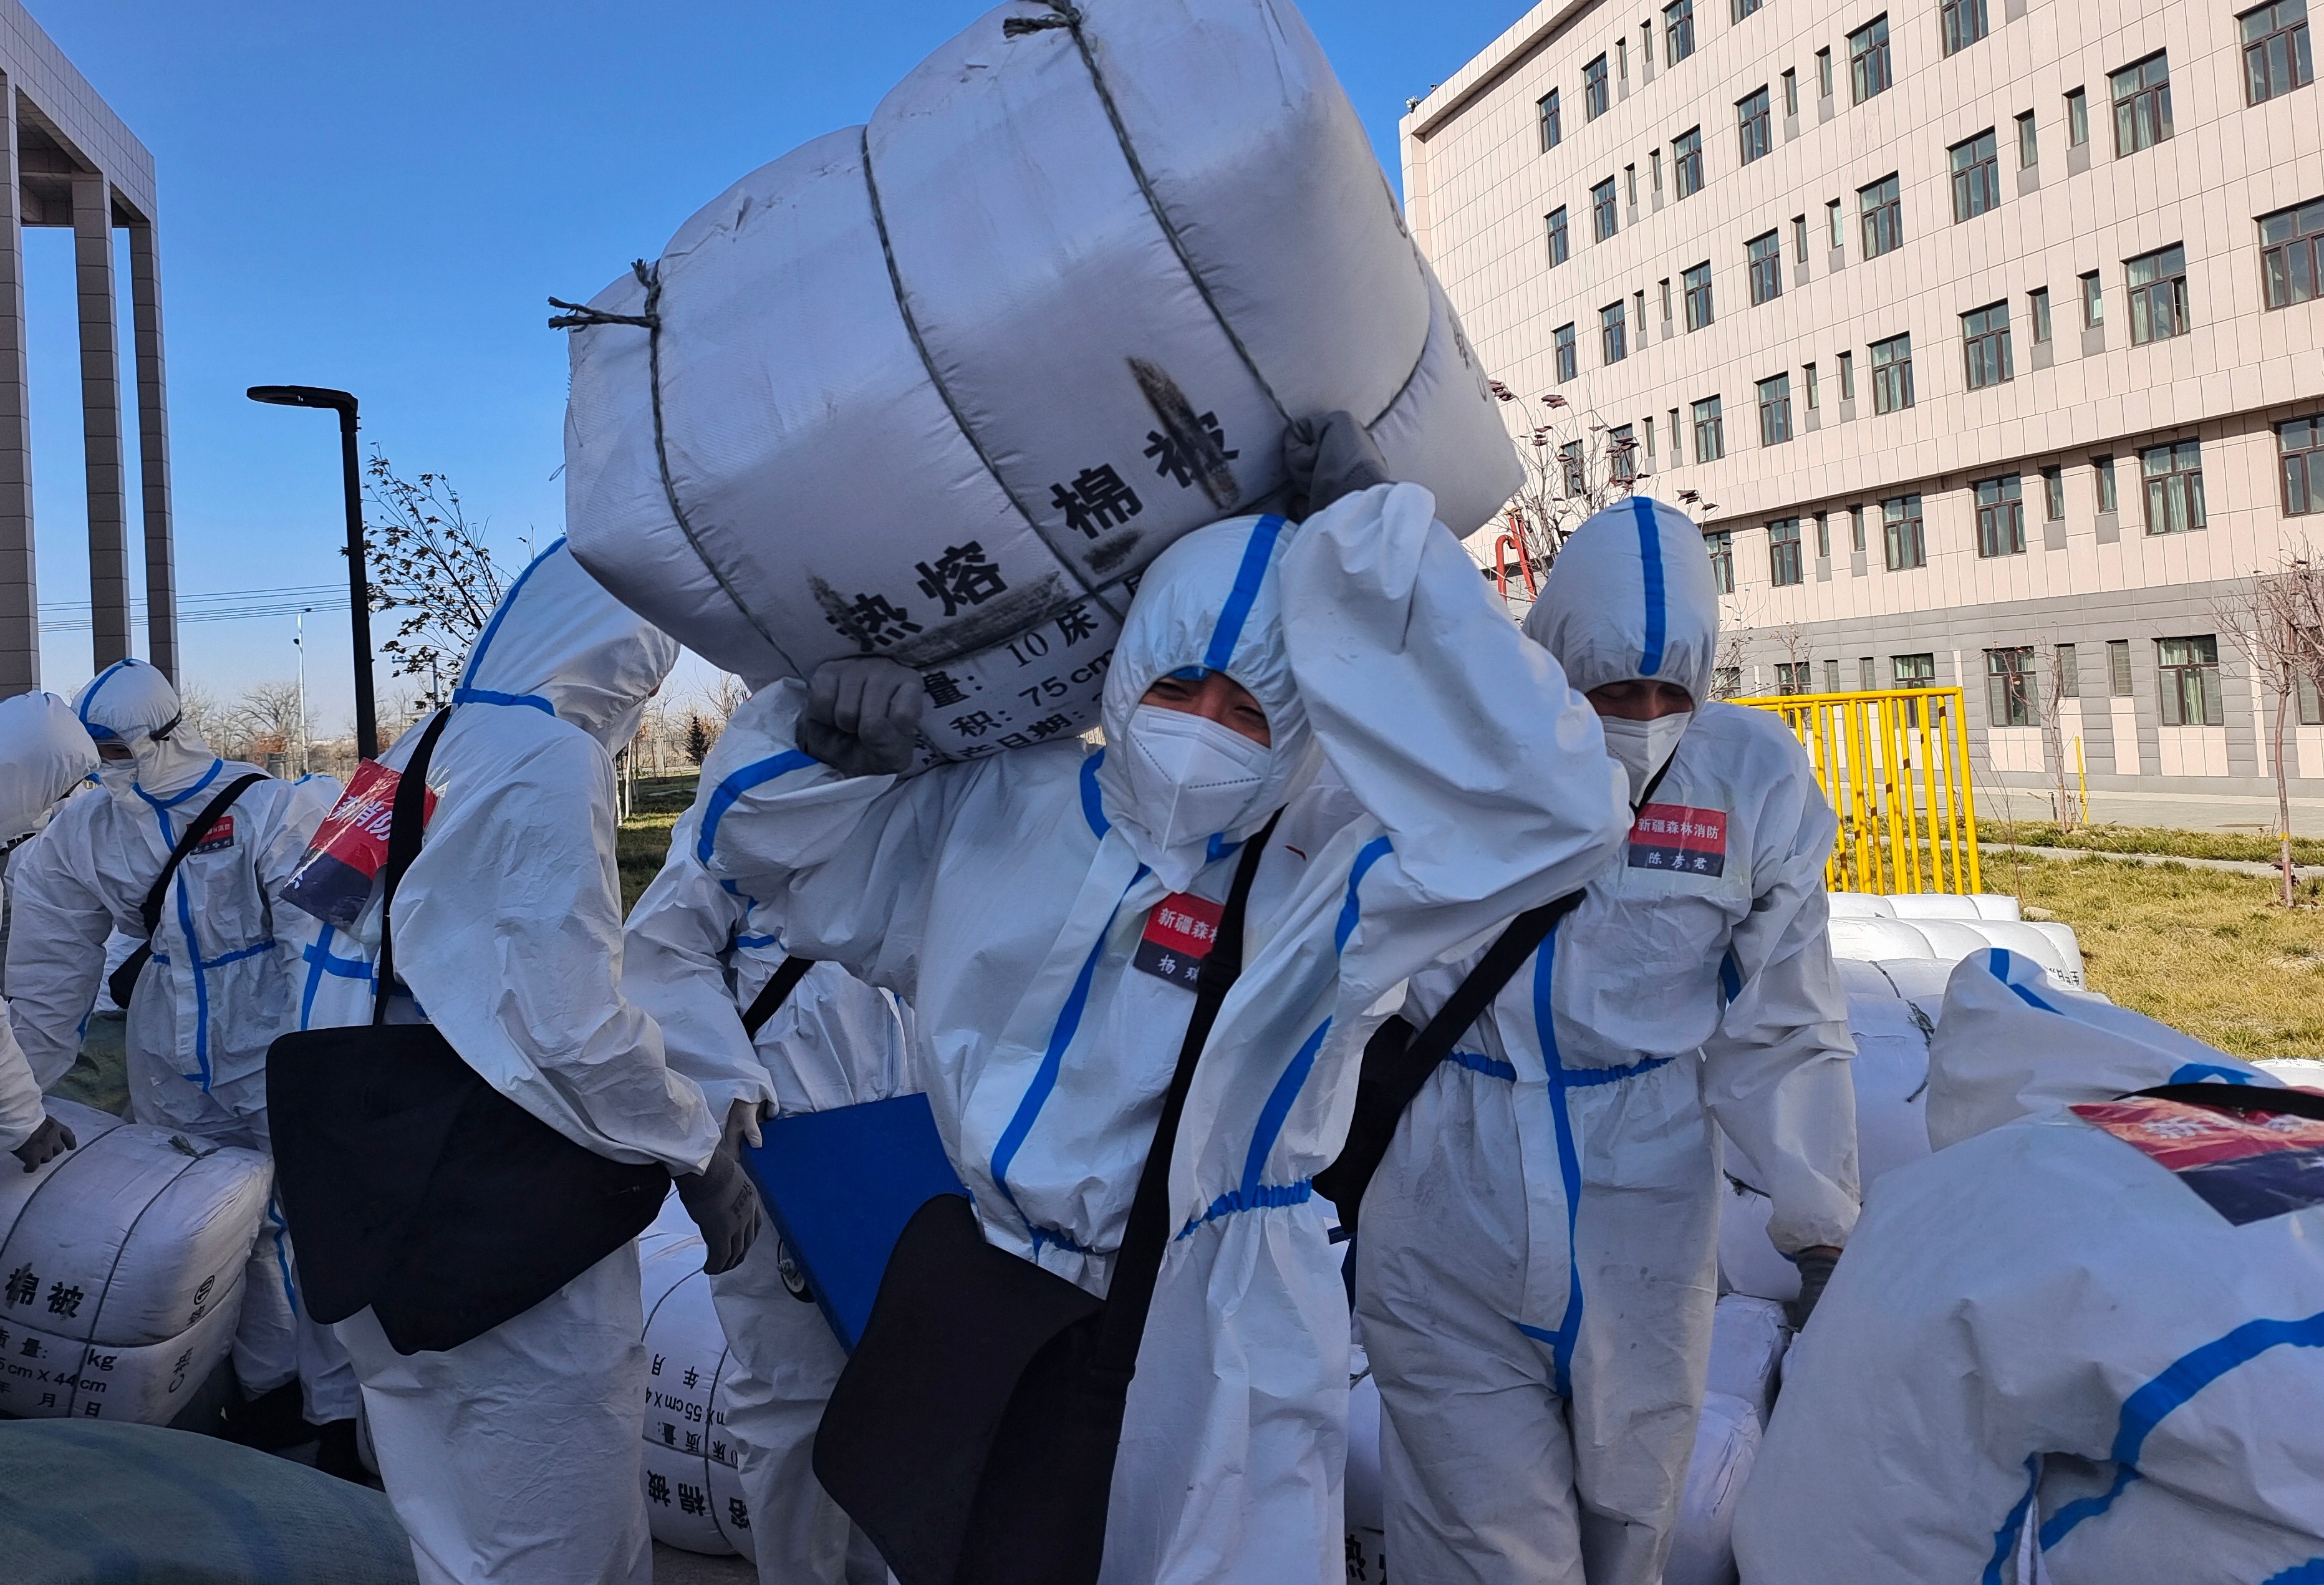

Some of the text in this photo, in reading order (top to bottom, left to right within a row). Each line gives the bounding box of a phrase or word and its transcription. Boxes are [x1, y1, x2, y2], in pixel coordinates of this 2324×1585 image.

[1005, 632, 1049, 668] 10
[1056, 604, 1099, 648] 床
[1638, 818, 1719, 840] 新疆森林消防
[1648, 852, 1707, 870] 陈彦君
[5, 1268, 85, 1319] 棉被
[87, 1348, 118, 1371] kg
